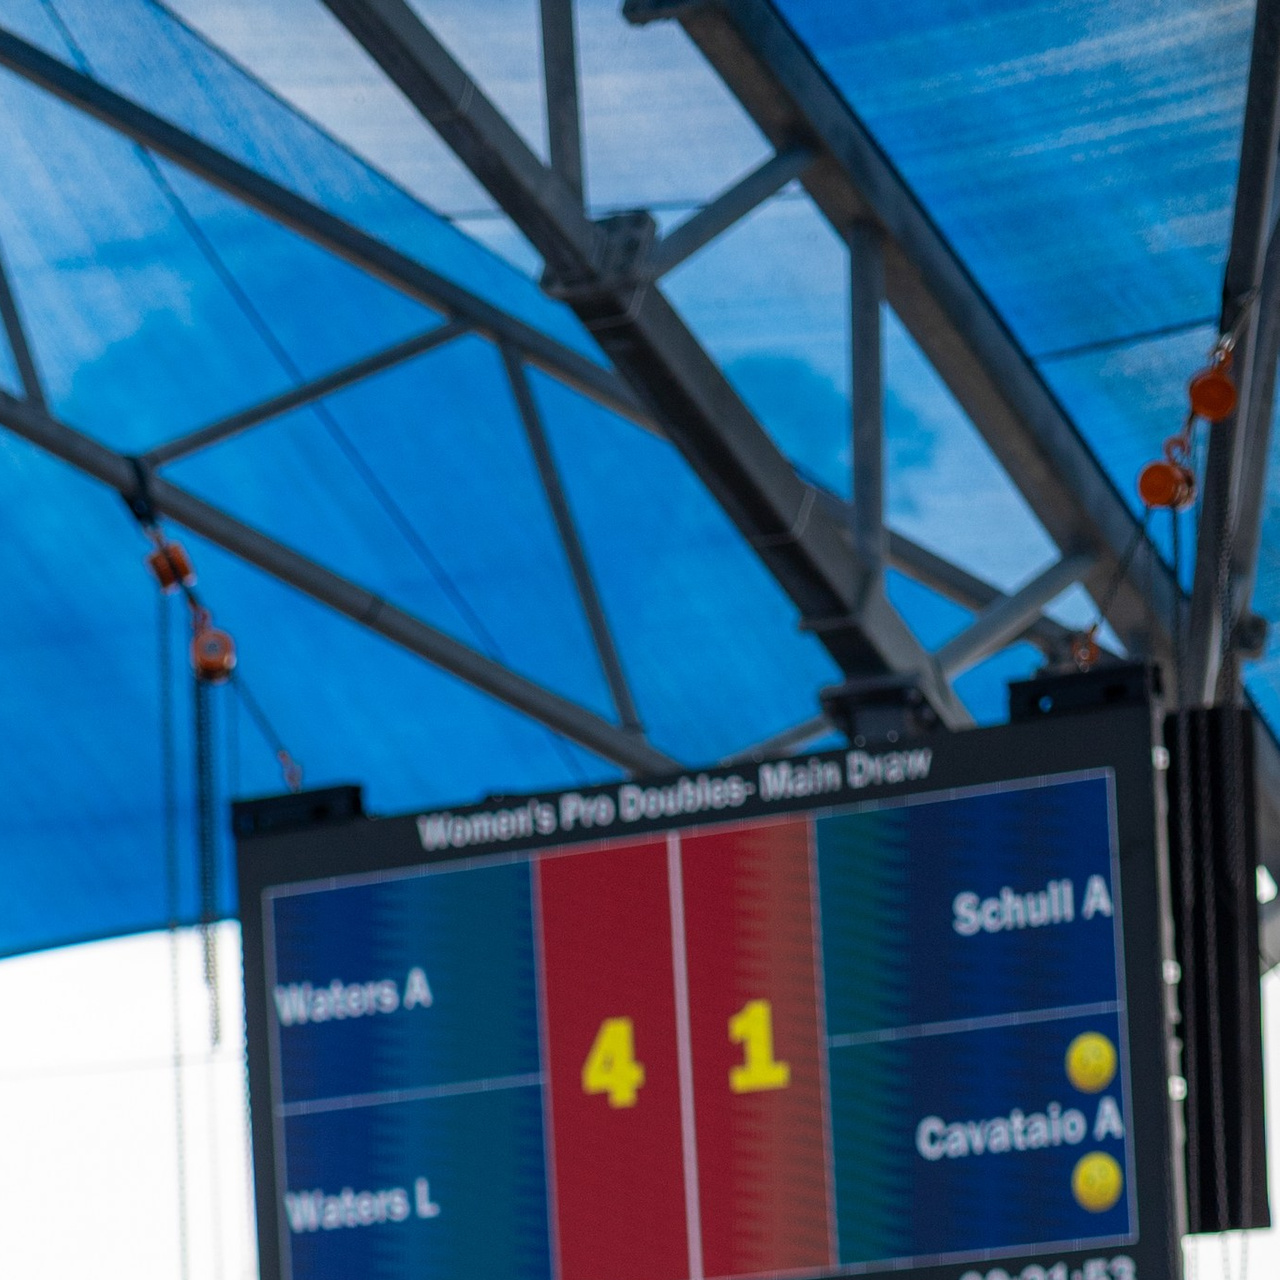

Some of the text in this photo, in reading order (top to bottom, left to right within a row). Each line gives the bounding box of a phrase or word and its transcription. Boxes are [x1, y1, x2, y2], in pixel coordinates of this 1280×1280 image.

[417, 799, 557, 851] Women's
[559, 793, 615, 830] Pro
[758, 758, 842, 799] Main
[846, 748, 934, 787] Draw
[952, 873, 1113, 937] Schull A
[274, 966, 433, 1025] Waters A
[582, 1016, 646, 1108] 4
[727, 998, 791, 1093] 1
[915, 1095, 1124, 1161] Cavataio A
[284, 1176, 440, 1233] Waters L
